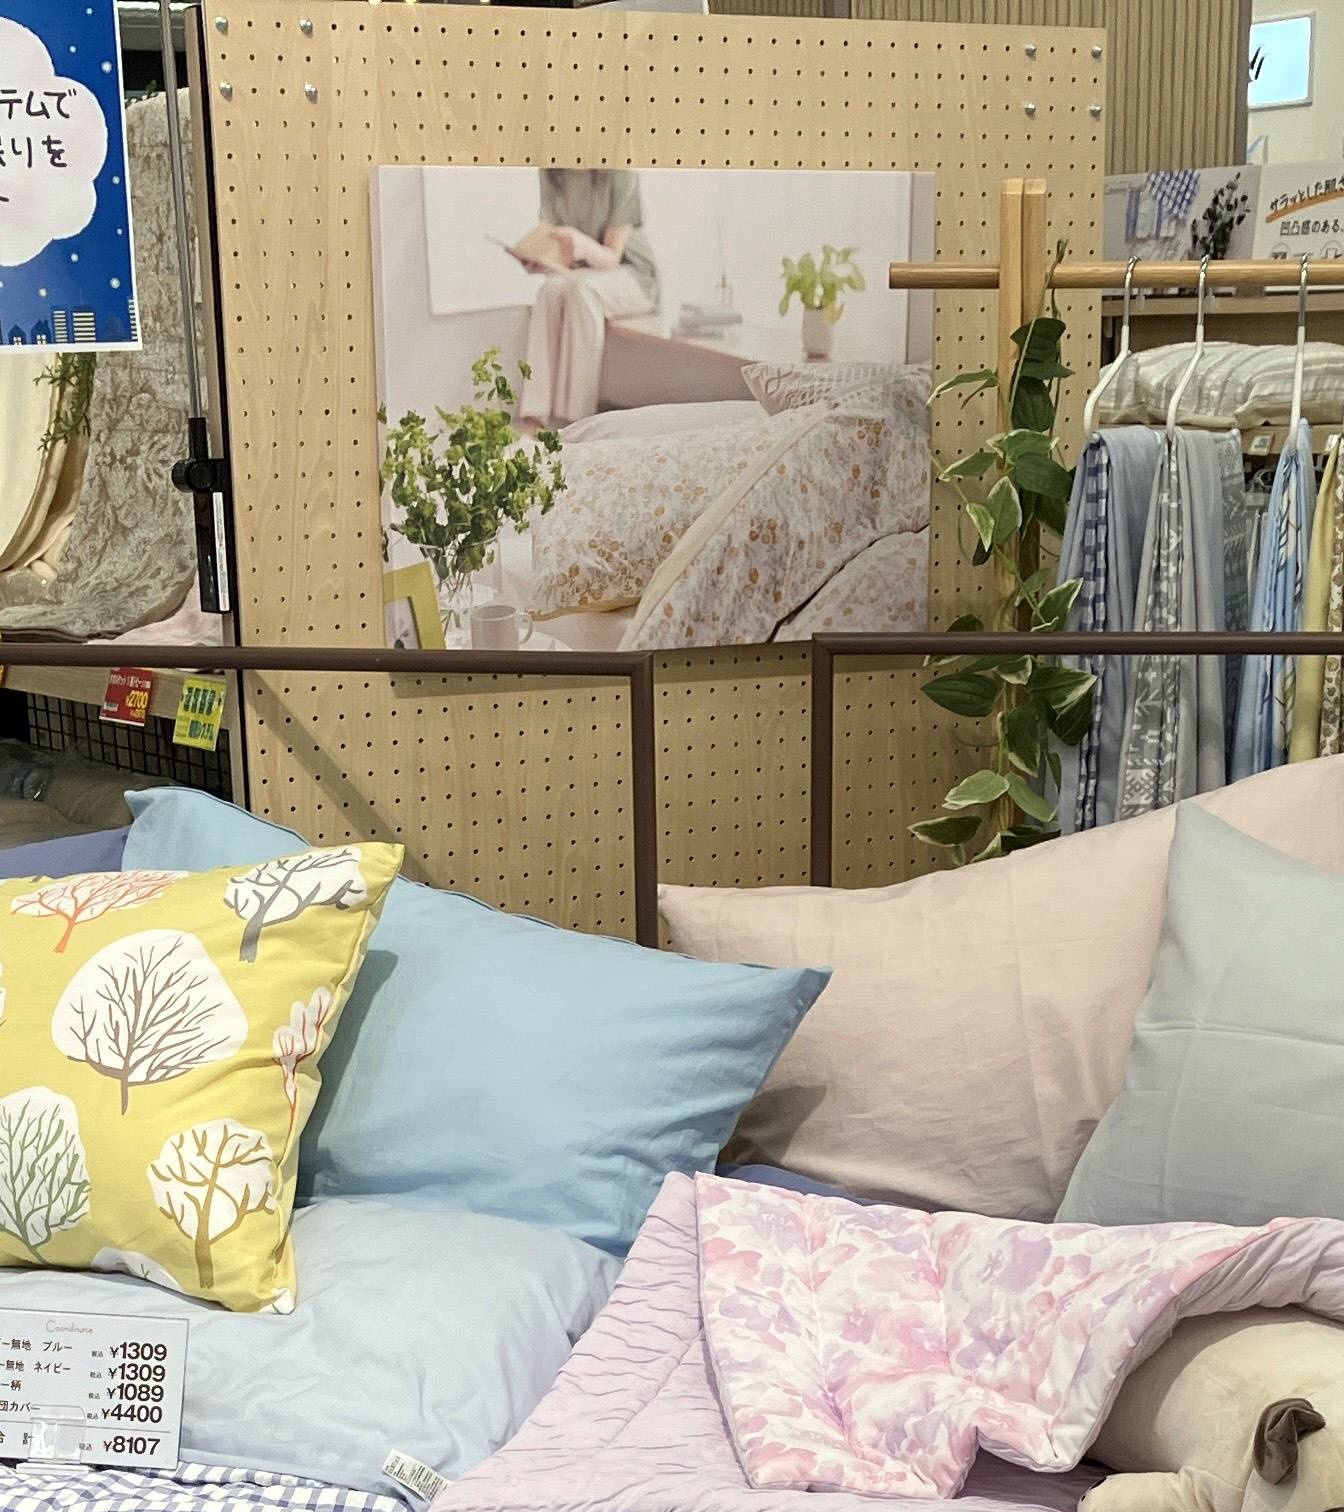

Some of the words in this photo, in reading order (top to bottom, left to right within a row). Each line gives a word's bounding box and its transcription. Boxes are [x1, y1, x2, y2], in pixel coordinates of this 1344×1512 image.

[42, 1340, 73, 1353] ブルー
[109, 1341, 168, 1362] ¥1309
[33, 1361, 72, 1374] ネイビー
[108, 1362, 166, 1383] ¥1309
[107, 1382, 165, 1403] ¥1089
[101, 1404, 163, 1424] ¥4400
[103, 1435, 162, 1456] ¥8107
